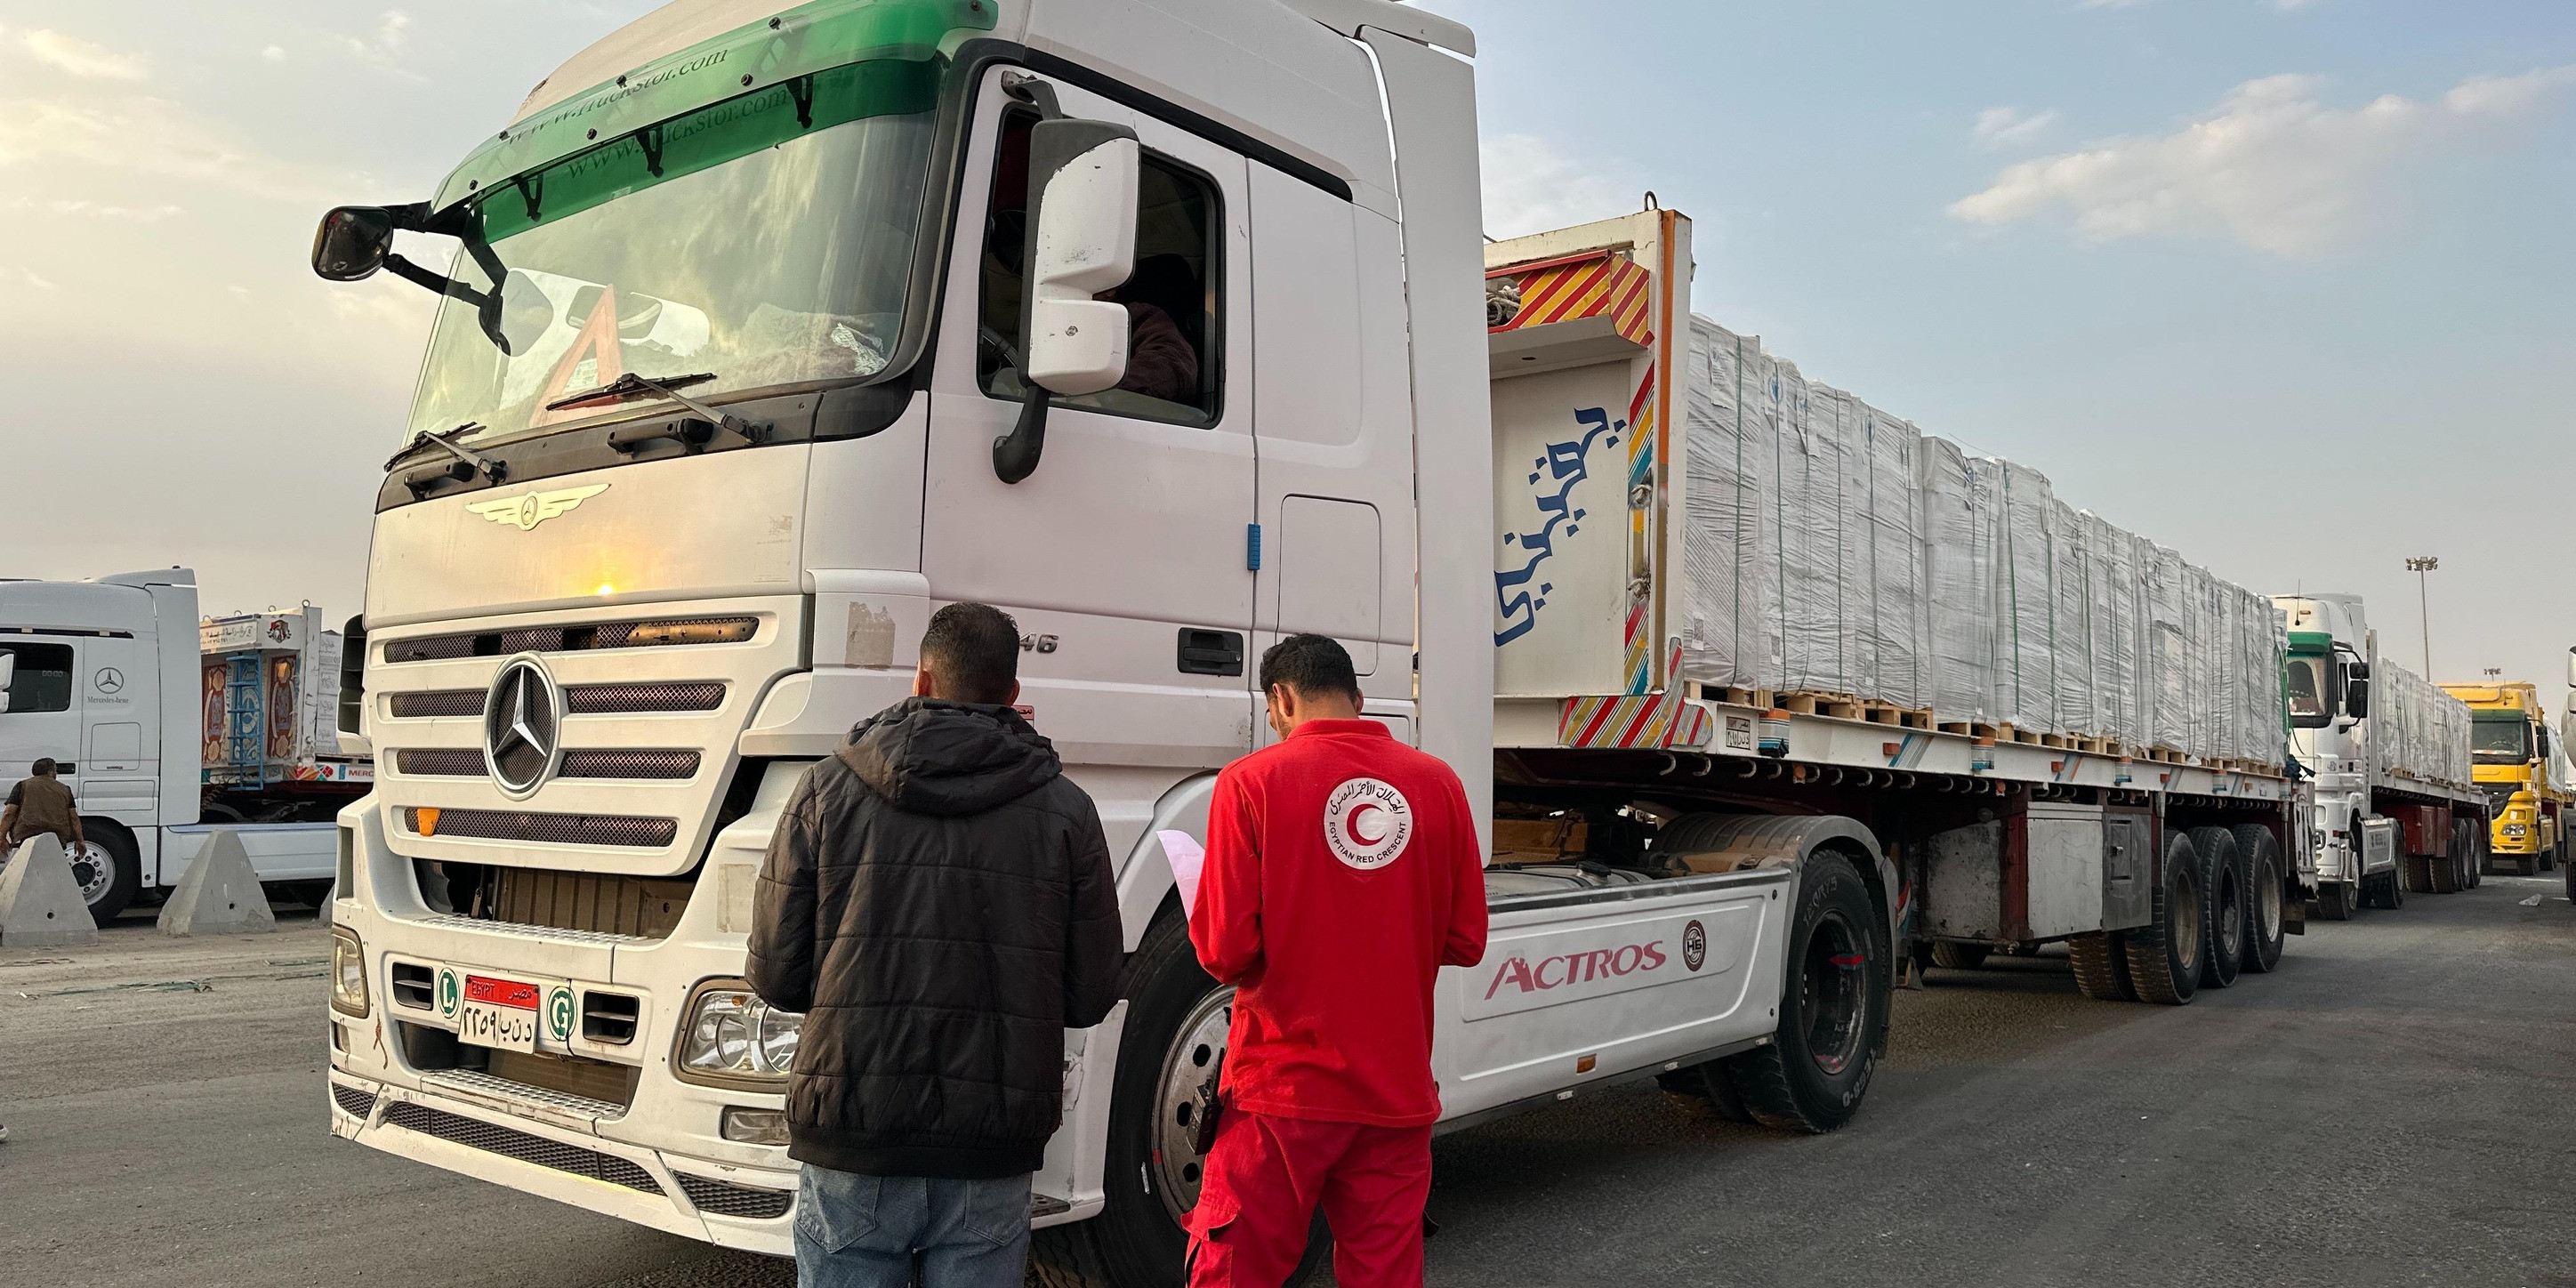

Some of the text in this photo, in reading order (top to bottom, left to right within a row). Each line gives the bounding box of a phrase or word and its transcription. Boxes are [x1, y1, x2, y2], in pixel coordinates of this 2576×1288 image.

[1329, 821, 1406, 863] EGYPTIAN RED CRESCENT
[443, 977, 455, 1010] L
[471, 980, 495, 999] EGYPT
[508, 987, 533, 1001] مصر
[552, 994, 570, 1032] G
